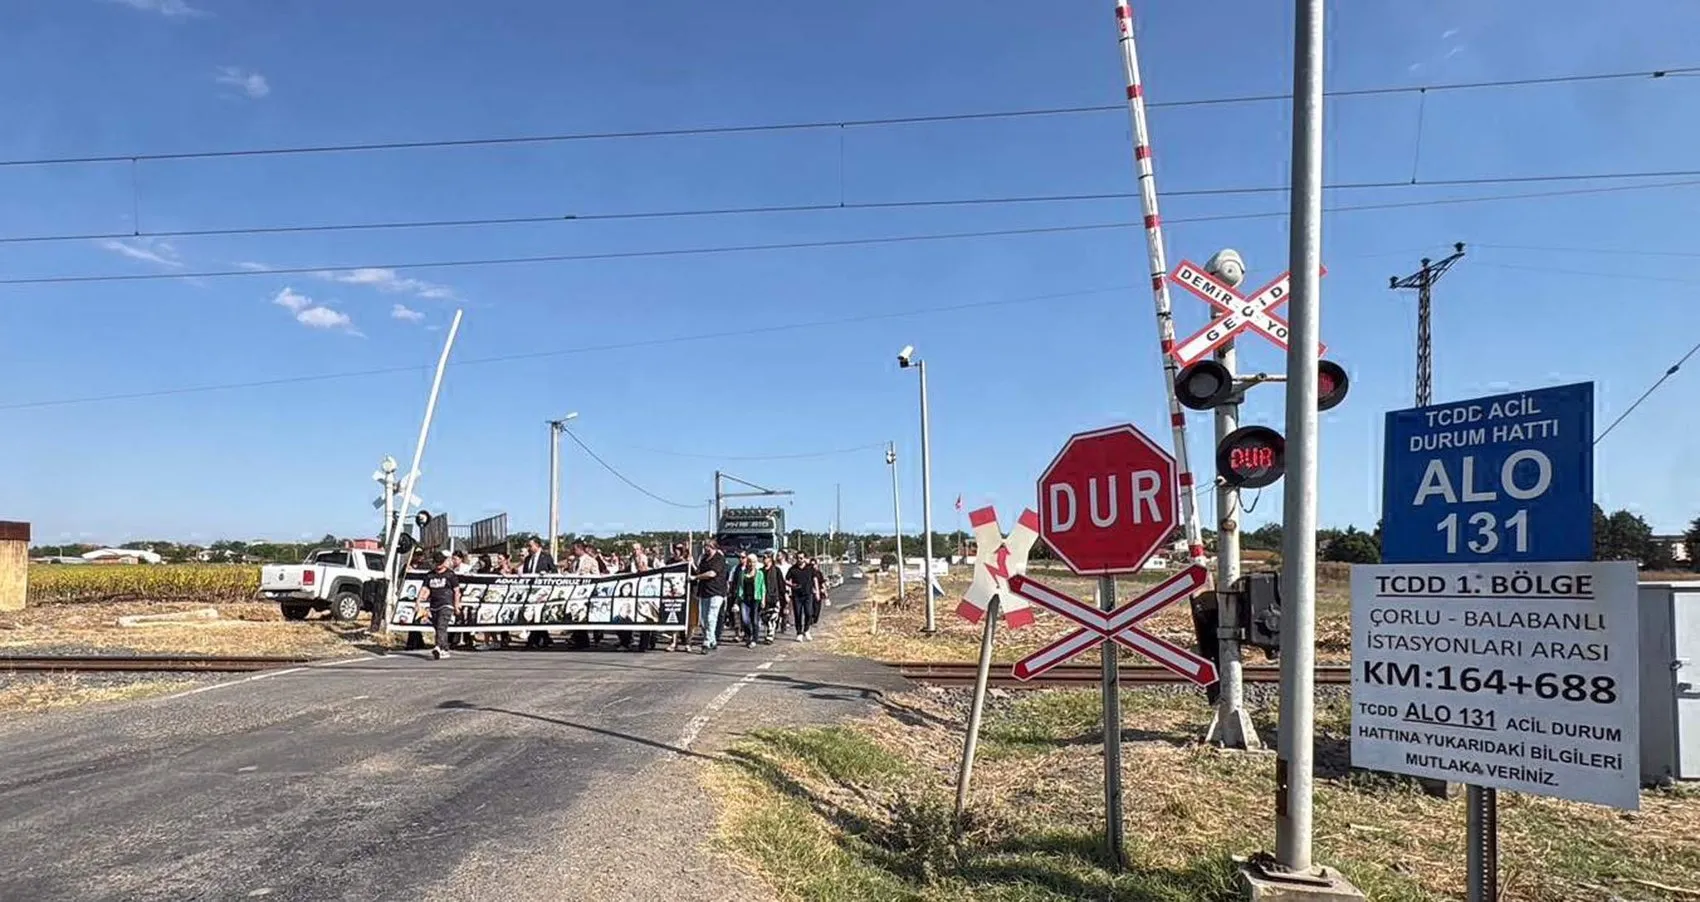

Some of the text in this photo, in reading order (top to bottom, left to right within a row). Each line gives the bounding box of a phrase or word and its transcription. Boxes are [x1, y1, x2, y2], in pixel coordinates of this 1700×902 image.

[1267, 320, 1288, 339] YO
[1426, 394, 1541, 427] TCDD ACİL
[1410, 419, 1559, 452] DURUM HATTI
[1230, 446, 1273, 469] DUR
[1412, 449, 1553, 506] ALO
[1051, 469, 1163, 533] DUR
[1436, 509, 1529, 554] 131
[1376, 576, 1446, 593] TCDD
[1491, 570, 1593, 595] BÖLGE
[1370, 608, 1441, 627] ÇORLU
[1367, 630, 1609, 661] İSTASYONLARI ARASI
[1364, 660, 1617, 705] KM:164+688
[1359, 702, 1621, 742] TCDD ALO 131 ACİL DURUM
[1359, 726, 1622, 770] HATTINA YUKARIDAKİ BİLGİLERİ
[1406, 753, 1483, 774] MUTLAKA
